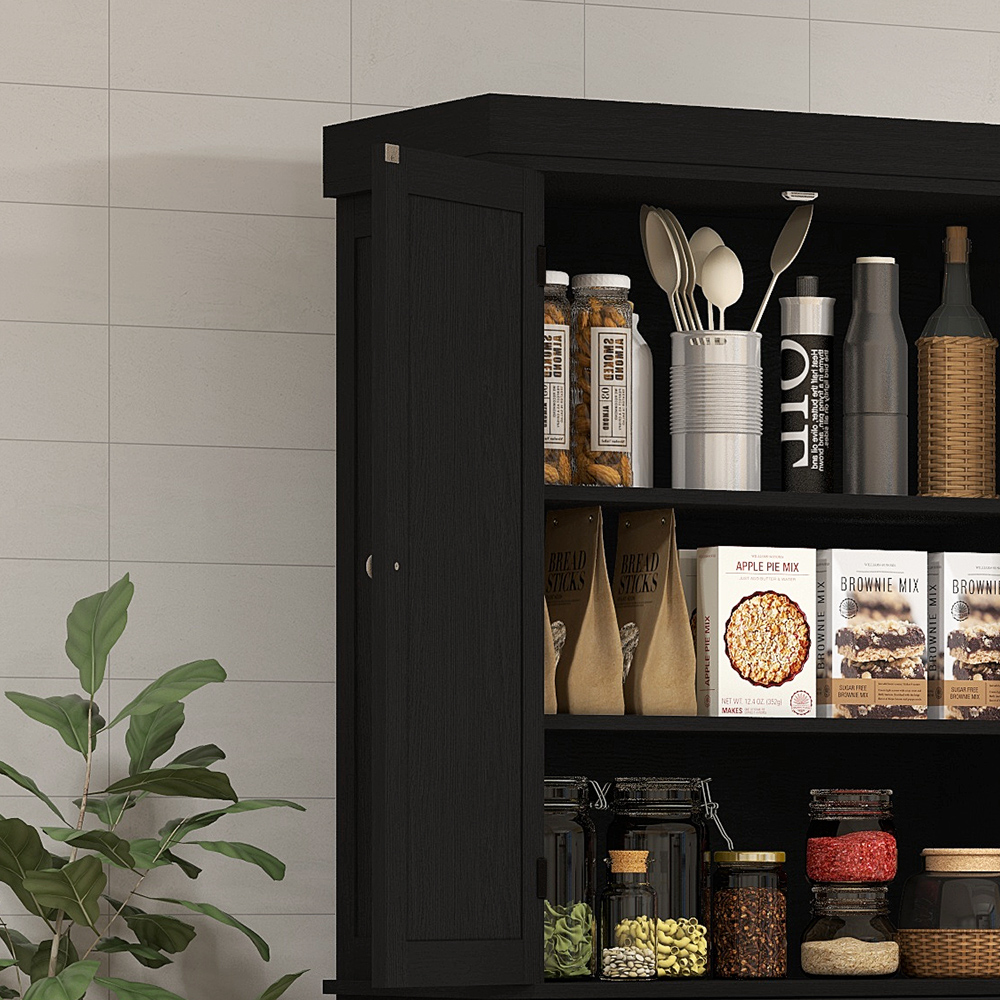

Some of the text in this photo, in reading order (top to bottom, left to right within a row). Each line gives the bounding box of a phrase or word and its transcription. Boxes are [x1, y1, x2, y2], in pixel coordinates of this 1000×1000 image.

[548, 550, 586, 572] BREAD
[621, 552, 660, 574] BREAD
[736, 562, 799, 572] APPLE PIE MIX
[546, 571, 586, 593] STICKS
[618, 573, 658, 594] STICKS
[841, 576, 919, 593] BROWNIE MIX
